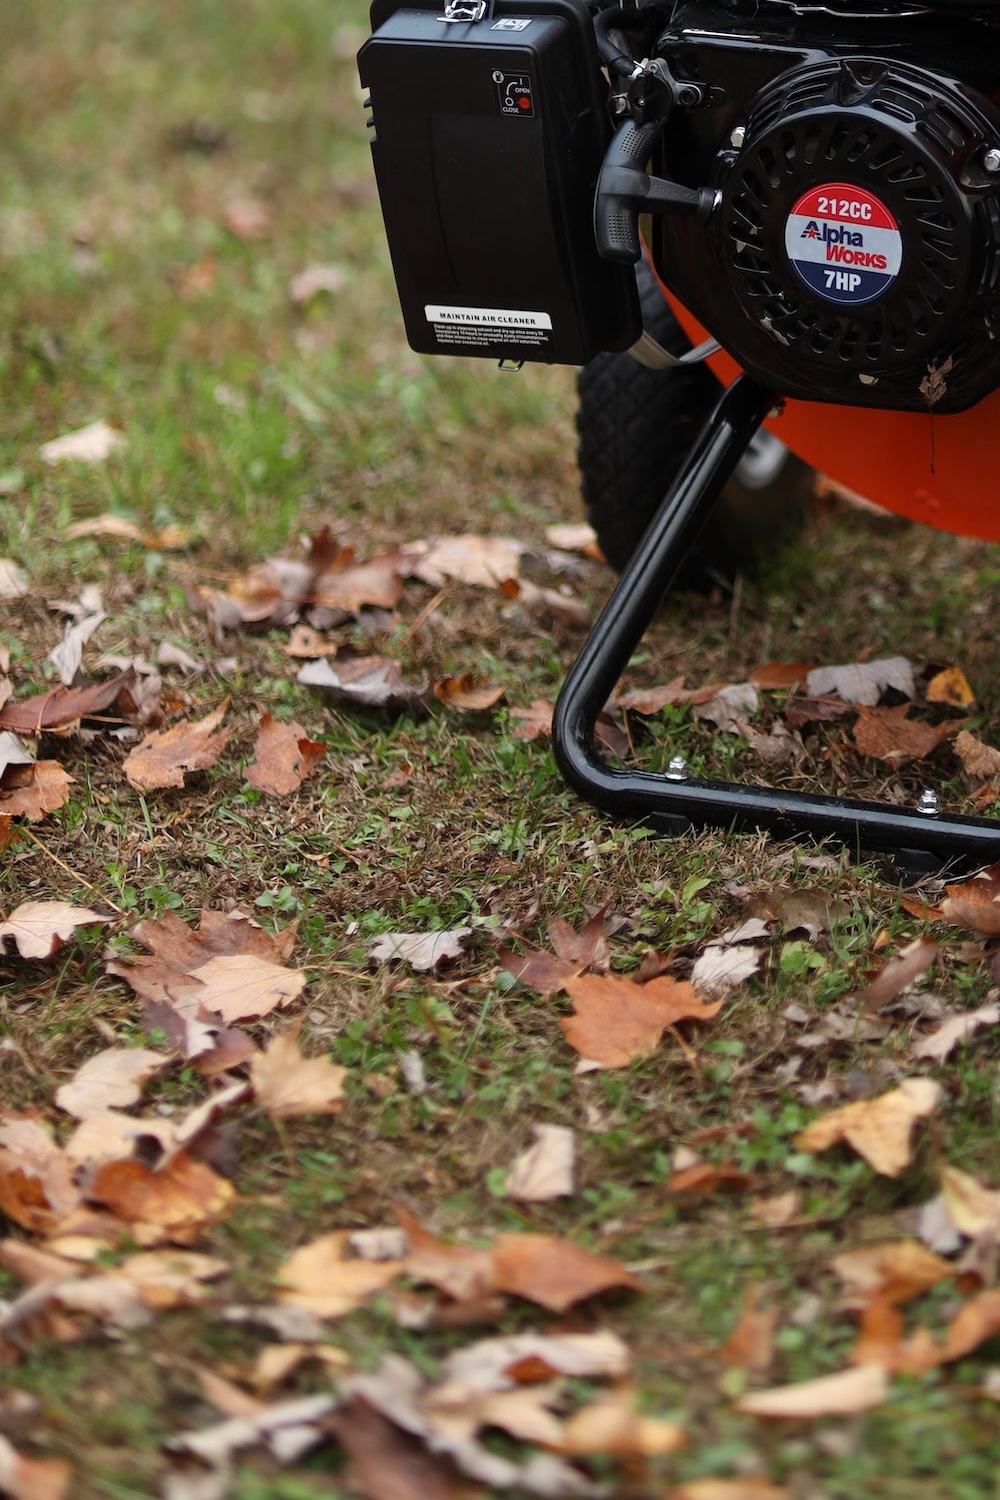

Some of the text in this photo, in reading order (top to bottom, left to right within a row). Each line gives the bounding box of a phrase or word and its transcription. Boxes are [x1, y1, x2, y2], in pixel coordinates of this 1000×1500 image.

[502, 106, 520, 114] CLOSE
[817, 196, 873, 220] 212CC
[800, 220, 863, 247] Alpha
[823, 269, 862, 292] 7HP
[440, 312, 480, 322] MAINTAIN
[497, 316, 536, 325] CLEANER
